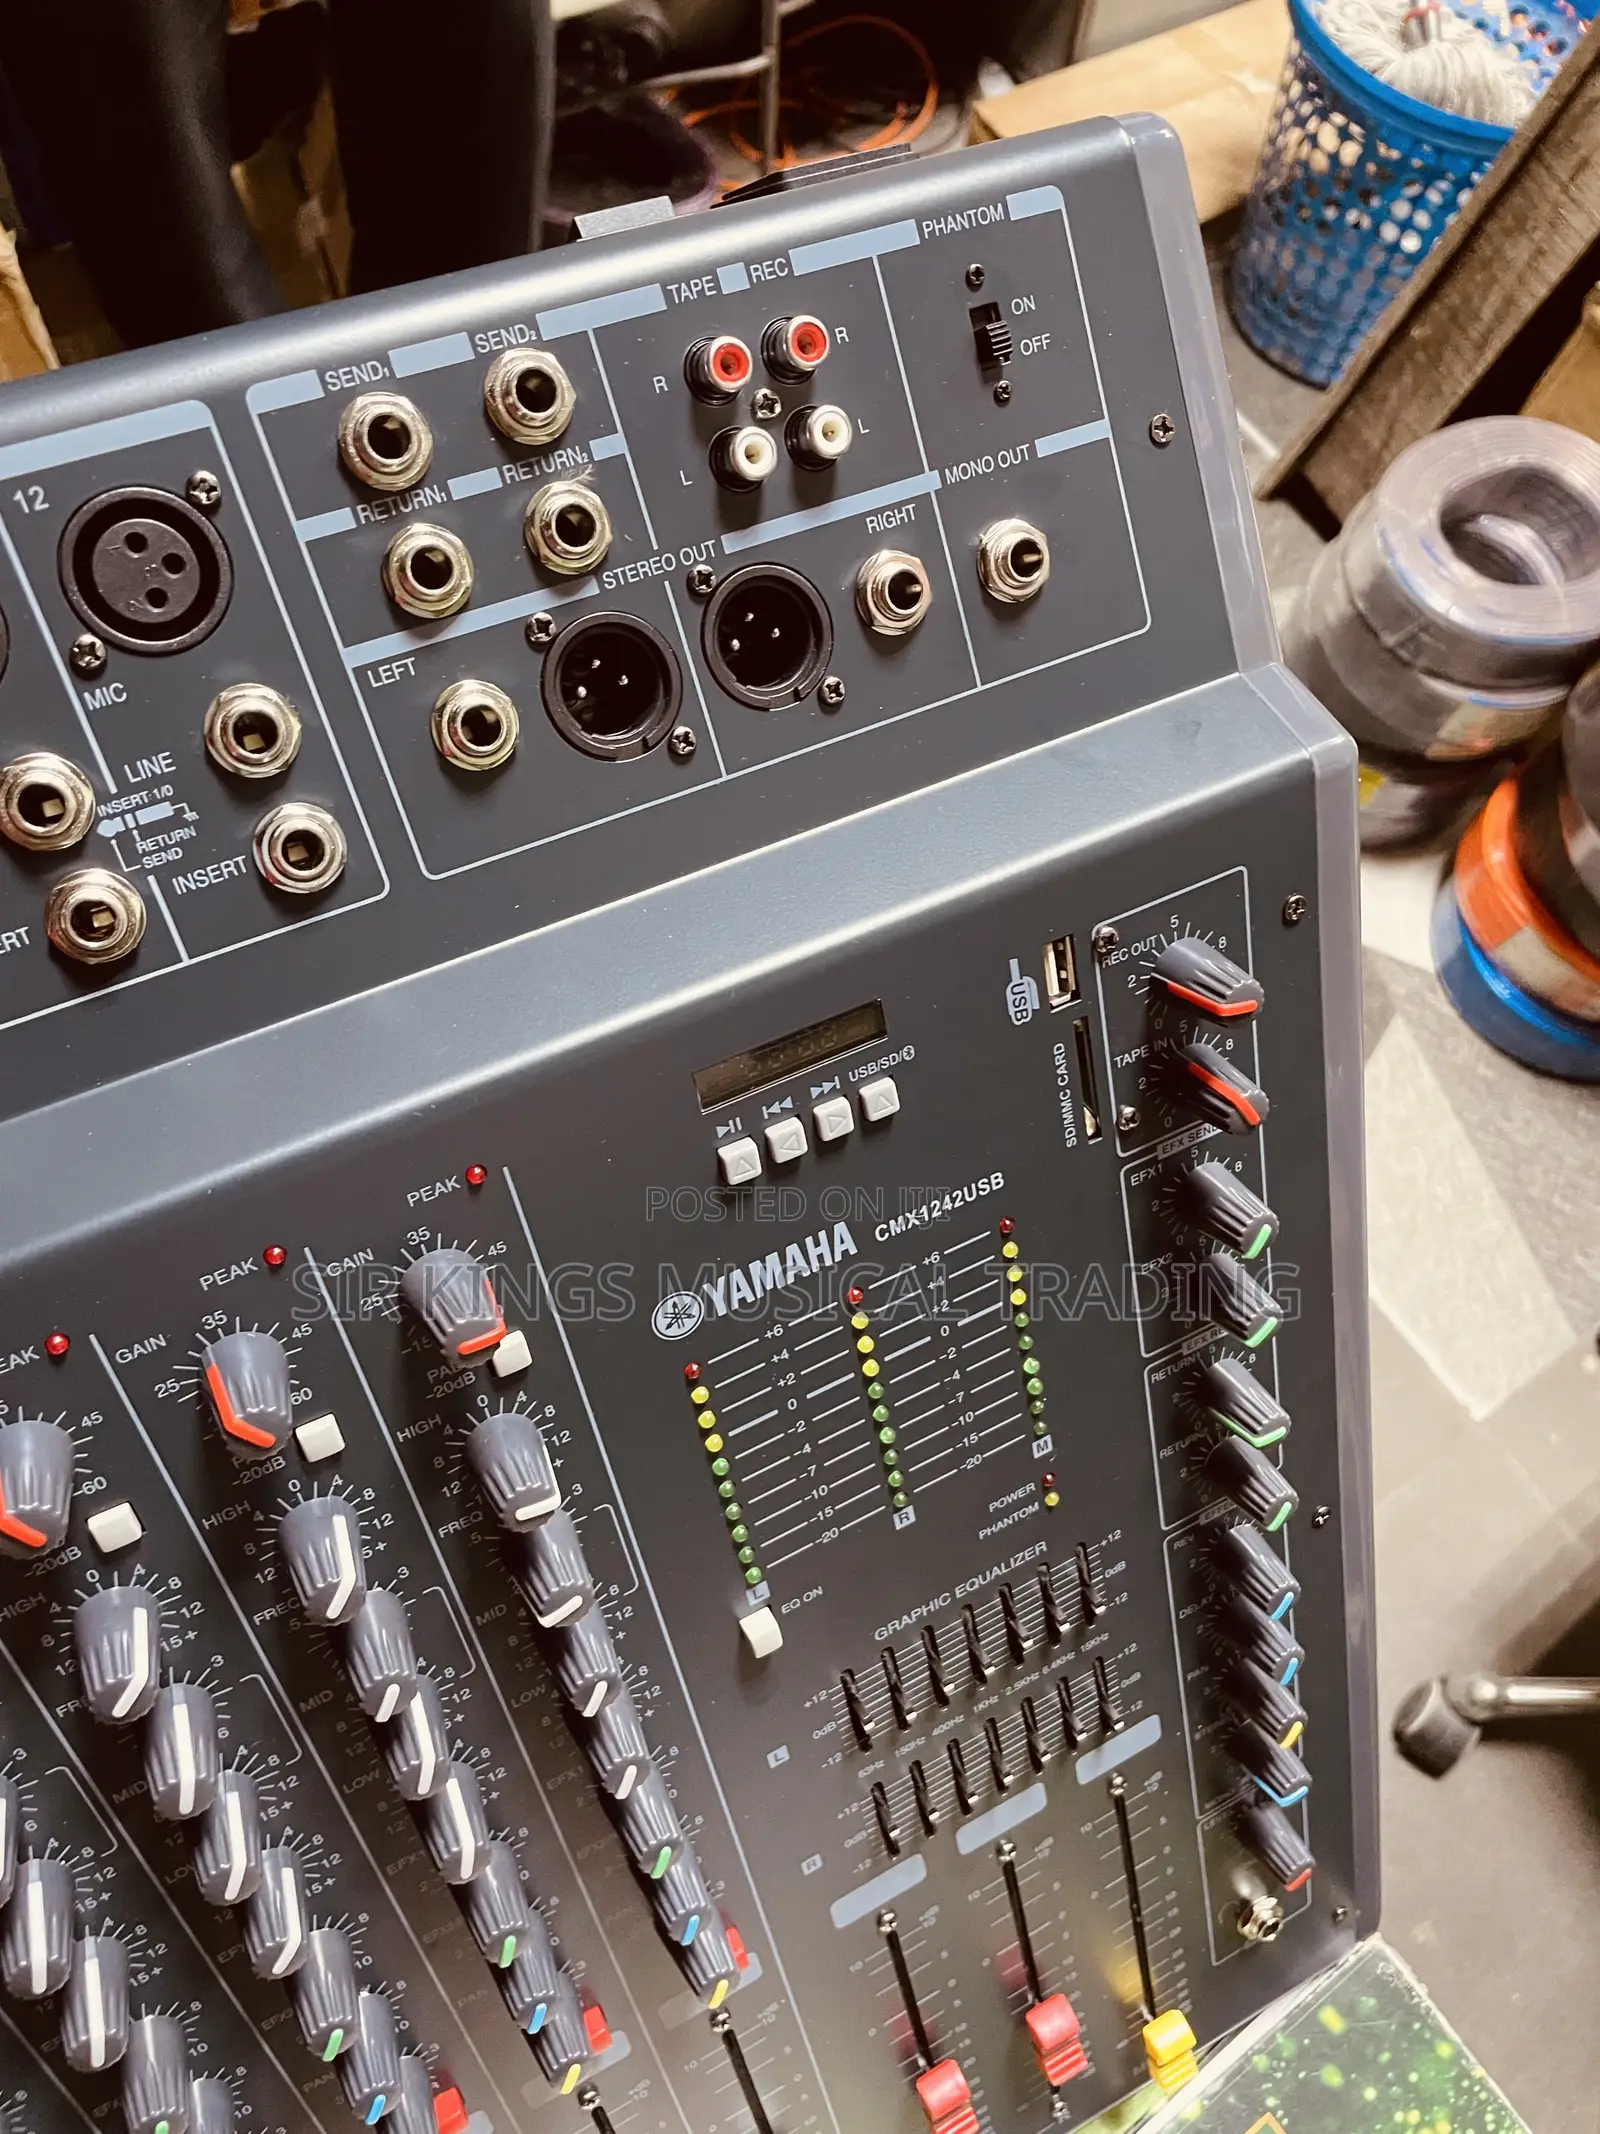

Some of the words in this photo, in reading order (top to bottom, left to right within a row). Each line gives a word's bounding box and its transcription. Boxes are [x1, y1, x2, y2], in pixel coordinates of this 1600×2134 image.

[922, 203, 1004, 239] PHANTOM
[750, 257, 789, 284] REC
[667, 277, 717, 304] TAPE
[1011, 295, 1036, 315] ON
[835, 327, 849, 345] R
[1019, 334, 1051, 357] OFF
[653, 376, 668, 393] R
[858, 419, 870, 434] L
[945, 459, 994, 485] MONO
[997, 445, 1030, 468] OUT
[681, 470, 692, 486] L
[13, 486, 50, 515] 12
[866, 504, 917, 534] RIGHT
[602, 554, 676, 590] STEREO
[679, 541, 717, 567] OUT
[367, 658, 416, 688] LEFT
[83, 682, 128, 710] MIC
[124, 752, 177, 783] LINE
[136, 826, 197, 854] RETURN
[142, 847, 183, 868] SEND
[172, 856, 249, 895] INSERT
[1170, 914, 1179, 928] 5
[1218, 936, 1227, 948] 8
[1102, 948, 1128, 968] REC
[1130, 935, 1158, 956] OUT
[1127, 975, 1136, 987] 2
[1010, 982, 1029, 1024] USB
[1154, 1018, 1162, 1030] 0
[1179, 1020, 1188, 1032] 5
[1114, 1046, 1150, 1068] TAPE
[1153, 1038, 1168, 1053] IN
[1225, 1038, 1233, 1051] 8
[1053, 1042, 1068, 1085] CARD
[1139, 1078, 1147, 1089] 2
[1059, 1089, 1077, 1148] SD/MMC
[1164, 1117, 1172, 1128] 0
[1162, 1138, 1184, 1154] EFX
[1191, 1146, 1199, 1157] 5
[1130, 1163, 1164, 1186] EFX1
[1235, 1161, 1243, 1172] 8
[407, 1176, 461, 1207] PEAK
[875, 1172, 1004, 1241] CMX1242USB
[407, 1226, 430, 1245] 35
[488, 1241, 507, 1257] 45
[326, 1248, 374, 1278] GAIN
[922, 1251, 941, 1268] +6
[199, 1257, 259, 1291] PEAK
[702, 1221, 857, 1317] YAMAHA
[927, 1276, 945, 1290] +4
[361, 1292, 383, 1313] 25
[932, 1300, 950, 1314] +2
[201, 1310, 227, 1329] 35
[292, 1324, 312, 1338] 45
[764, 1324, 783, 1340] +6
[941, 1325, 949, 1337] 0
[115, 1333, 166, 1364] GAIN
[771, 1348, 789, 1363] +4
[777, 1372, 796, 1387] +2
[155, 1379, 180, 1398] 25
[290, 1387, 312, 1405] 60
[477, 1394, 488, 1407] 0
[788, 1398, 797, 1410] 0
[82, 1412, 103, 1426] 45
[544, 1406, 555, 1416] 8
[396, 1415, 442, 1442] HIGH
[551, 1430, 572, 1447] 12
[1035, 1438, 1049, 1454] M
[364, 1489, 375, 1500] 8
[441, 1482, 462, 1498] 12
[572, 1484, 582, 1494] 3
[988, 1483, 1036, 1513] POWER
[202, 1502, 251, 1531] HIGH
[372, 1514, 394, 1530] 12
[438, 1511, 484, 1538] FREQ
[899, 1510, 910, 1525] R
[978, 1502, 1039, 1540] PHANTOM
[1100, 1529, 1121, 1547] +12
[87, 1570, 99, 1582] 0
[255, 1568, 277, 1584] 12
[398, 1567, 409, 1578] 3
[1104, 1560, 1127, 1578] 0dB
[169, 1577, 182, 1589] 8
[874, 1593, 951, 1641] GRAPHIC
[954, 1541, 1048, 1599] EQUALIZER
[781, 1597, 802, 1615] EQ
[803, 1585, 822, 1604] ON
[180, 1602, 205, 1619] 12
[476, 1604, 507, 1626] MID
[615, 1606, 634, 1620] 12
[211, 1656, 224, 1667] 3
[452, 1689, 472, 1702] 12
[804, 1690, 828, 1709] +12
[218, 1727, 228, 1738] 6
[812, 1721, 836, 1740] 0dB
[277, 1776, 299, 1791] 12
[321, 1853, 342, 1869] 12
[93, 1866, 117, 1884] 12
[146, 1943, 167, 1958] 12
